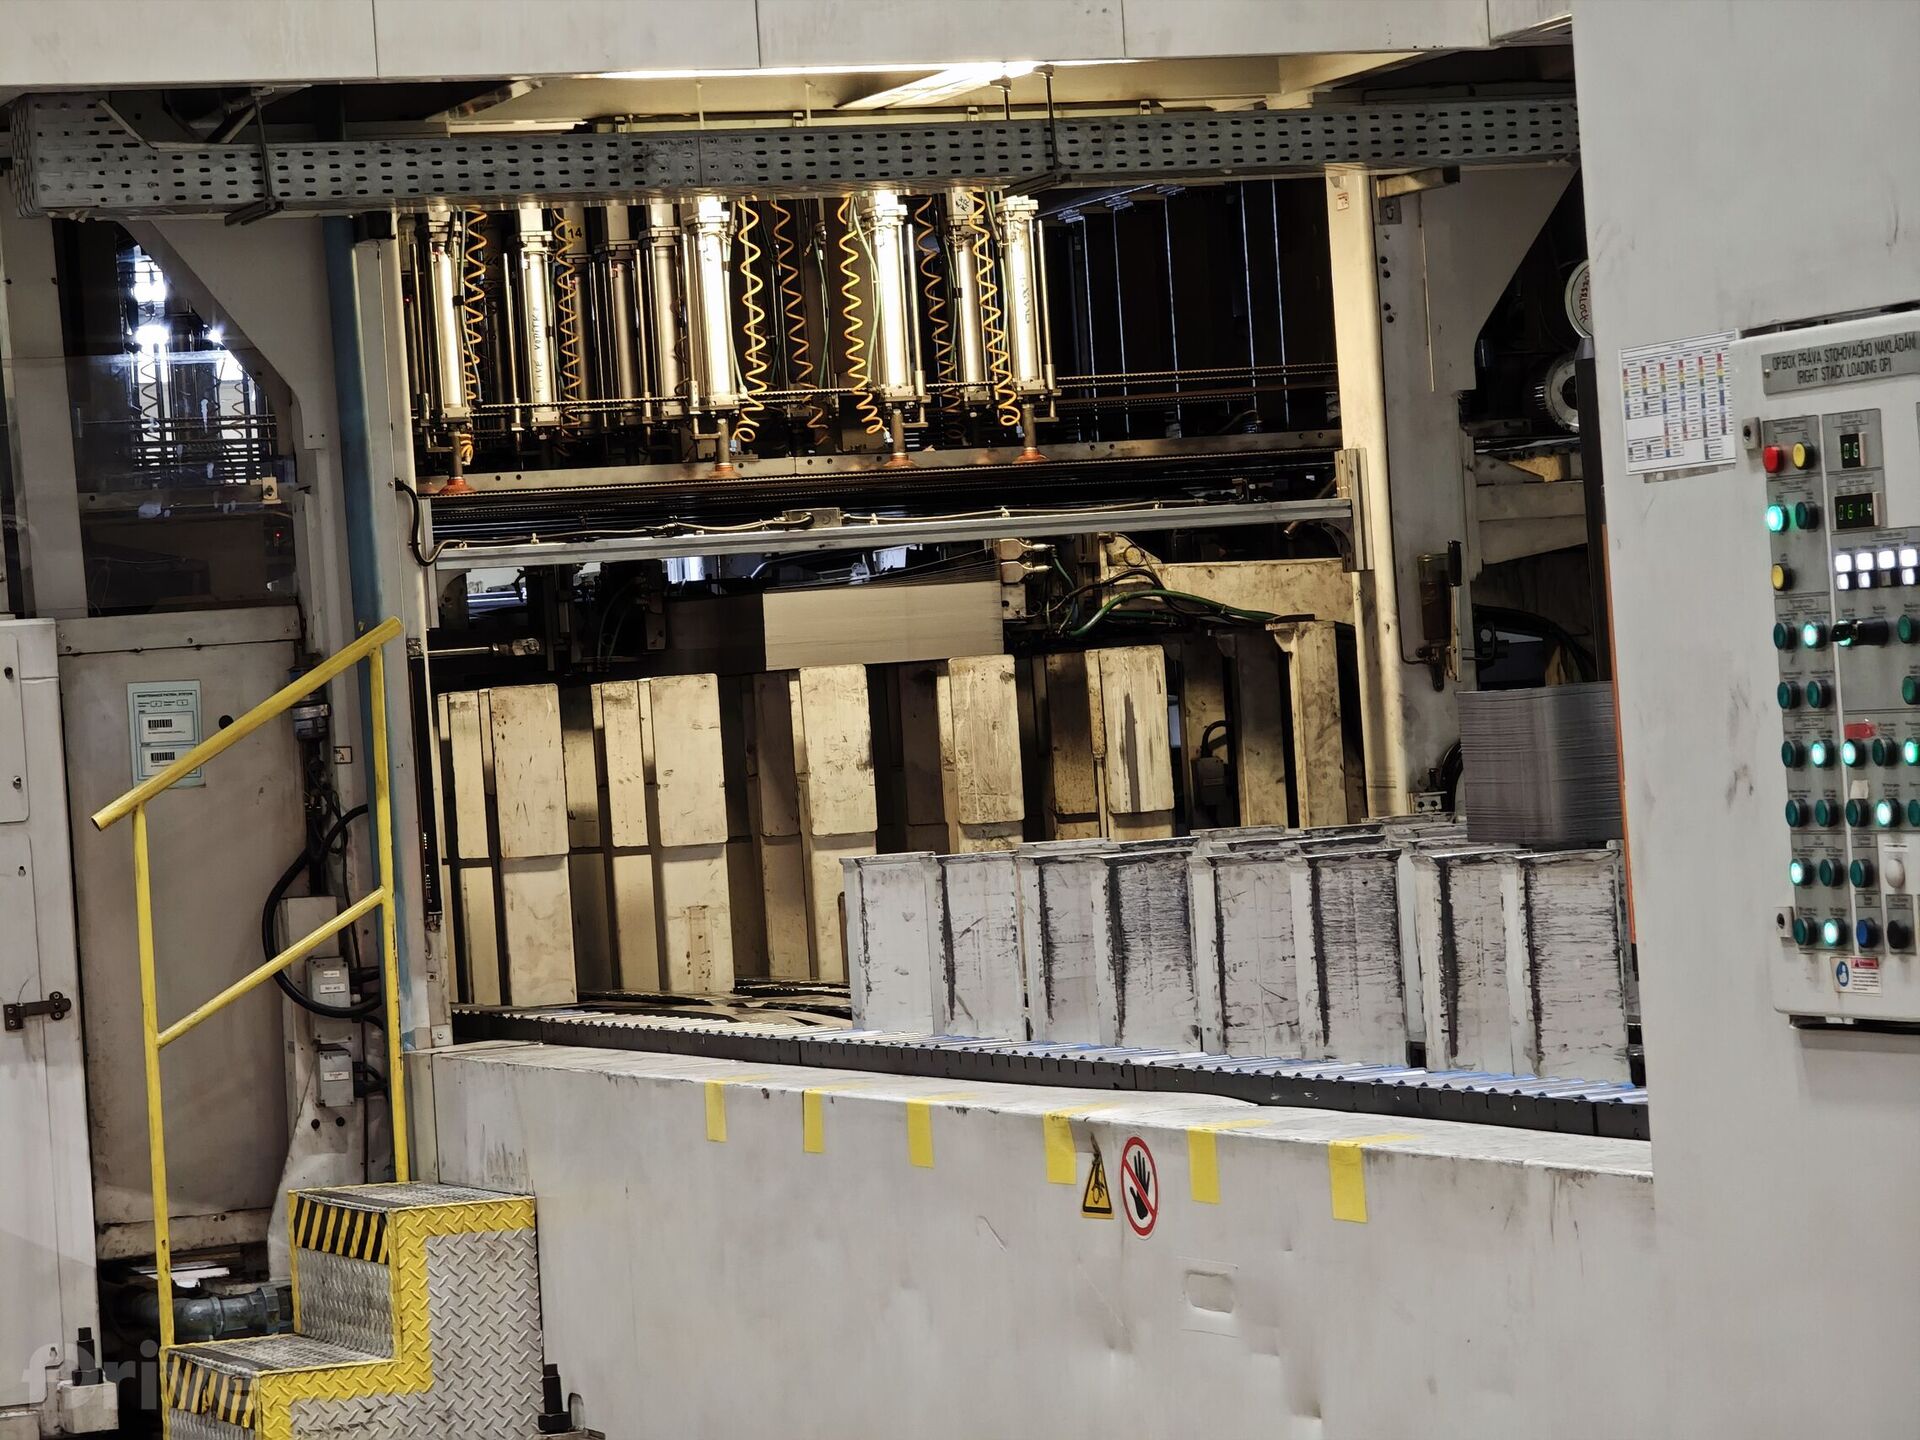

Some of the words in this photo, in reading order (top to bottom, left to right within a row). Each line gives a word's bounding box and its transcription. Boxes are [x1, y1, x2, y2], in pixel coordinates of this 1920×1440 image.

[567, 227, 583, 239] 14
[1821, 362, 1845, 381] STACK
[1846, 358, 1878, 378] LOADING
[1843, 442, 1859, 460] 06
